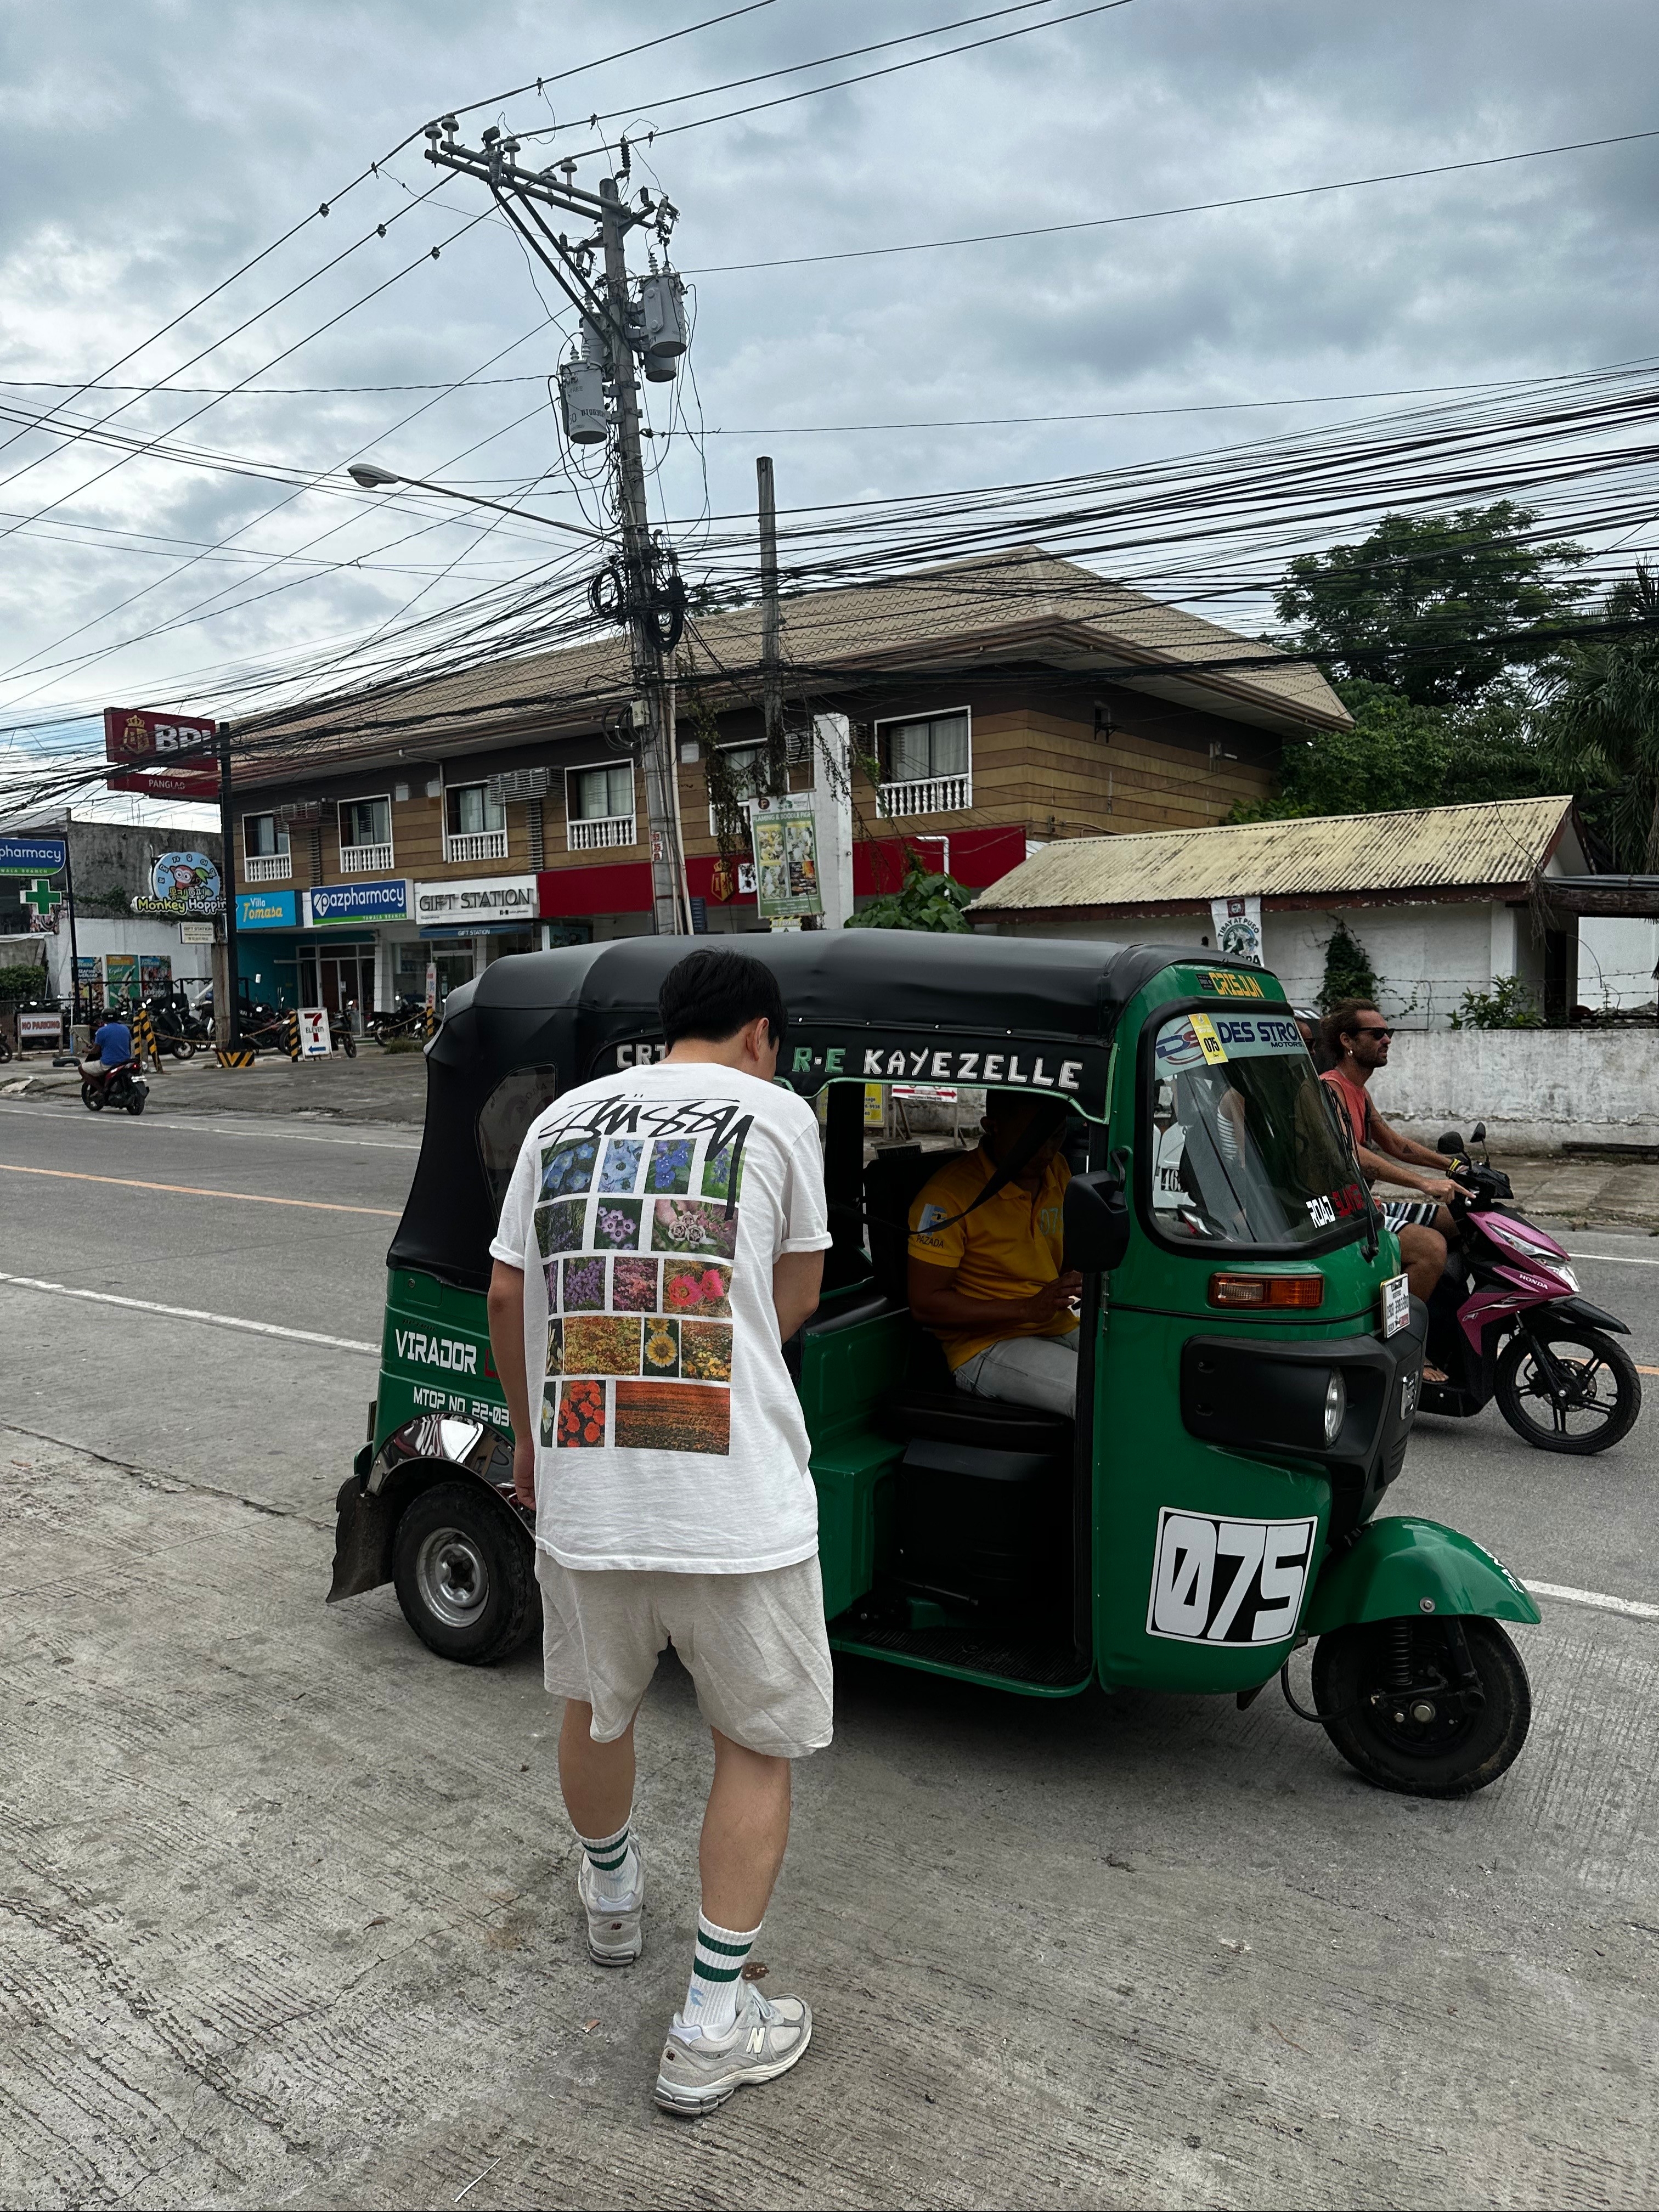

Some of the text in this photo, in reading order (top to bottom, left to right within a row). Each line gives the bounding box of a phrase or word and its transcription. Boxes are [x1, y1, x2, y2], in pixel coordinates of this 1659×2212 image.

[148, 778, 185, 790] PANGLAO
[138, 896, 227, 913] Monkey Hoppin
[250, 898, 266, 907] Villa
[420, 888, 531, 912] GIFT STATION
[243, 903, 284, 923] Tomasa
[1218, 919, 1233, 938] TIBAY
[1243, 918, 1260, 934] PUSO
[22, 1020, 60, 1030] NO PARKING
[304, 1013, 323, 1042] 7
[1216, 1021, 1256, 1044] DES
[1256, 1021, 1302, 1042] STRO
[1204, 1036, 1221, 1053] 075
[862, 1046, 1085, 1090] KAYEZELLE
[1306, 1195, 1336, 1228] ROAD
[1519, 1273, 1549, 1290] HONDA
[395, 1328, 477, 1375] VIRADOR
[413, 1386, 445, 1409] MTOP
[472, 1401, 511, 1427] 22-03
[1154, 1514, 1310, 1641] 075
[746, 2026, 766, 2054] N
